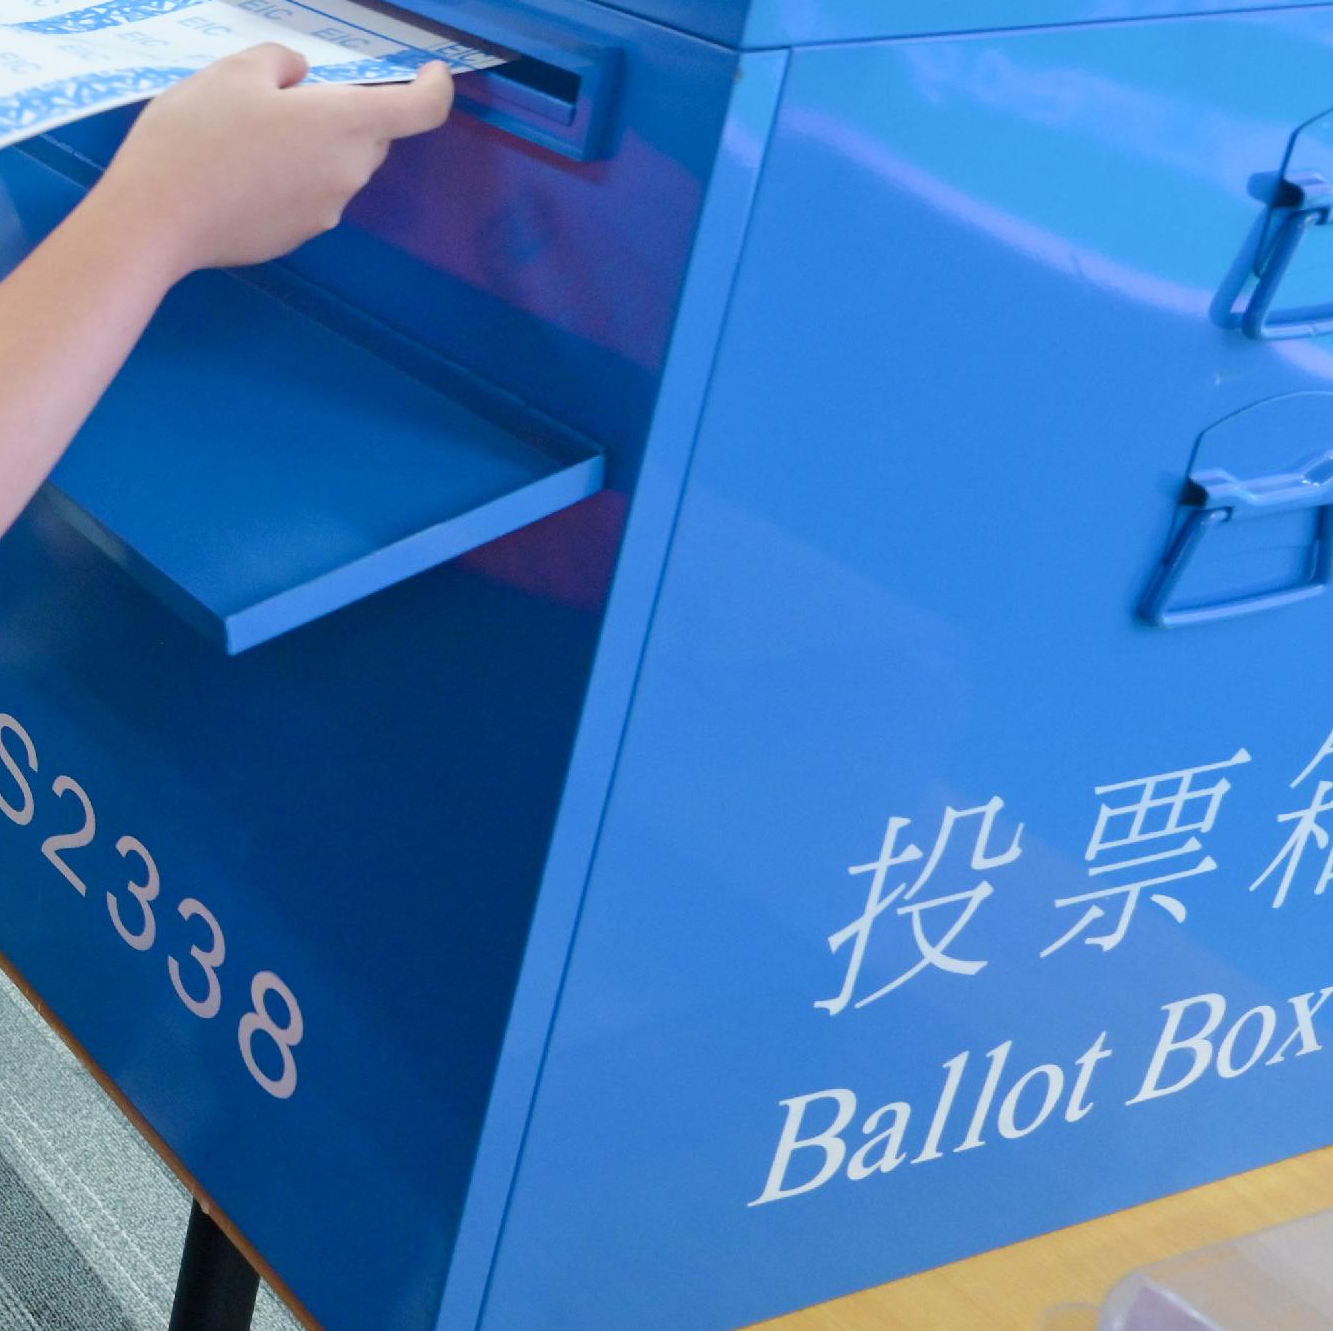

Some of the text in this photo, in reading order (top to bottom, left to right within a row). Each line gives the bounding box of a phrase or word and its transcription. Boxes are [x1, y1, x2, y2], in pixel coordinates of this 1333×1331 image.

[312, 26, 371, 49] EIC
[746, 985, 1333, 1208] Ballot Box
